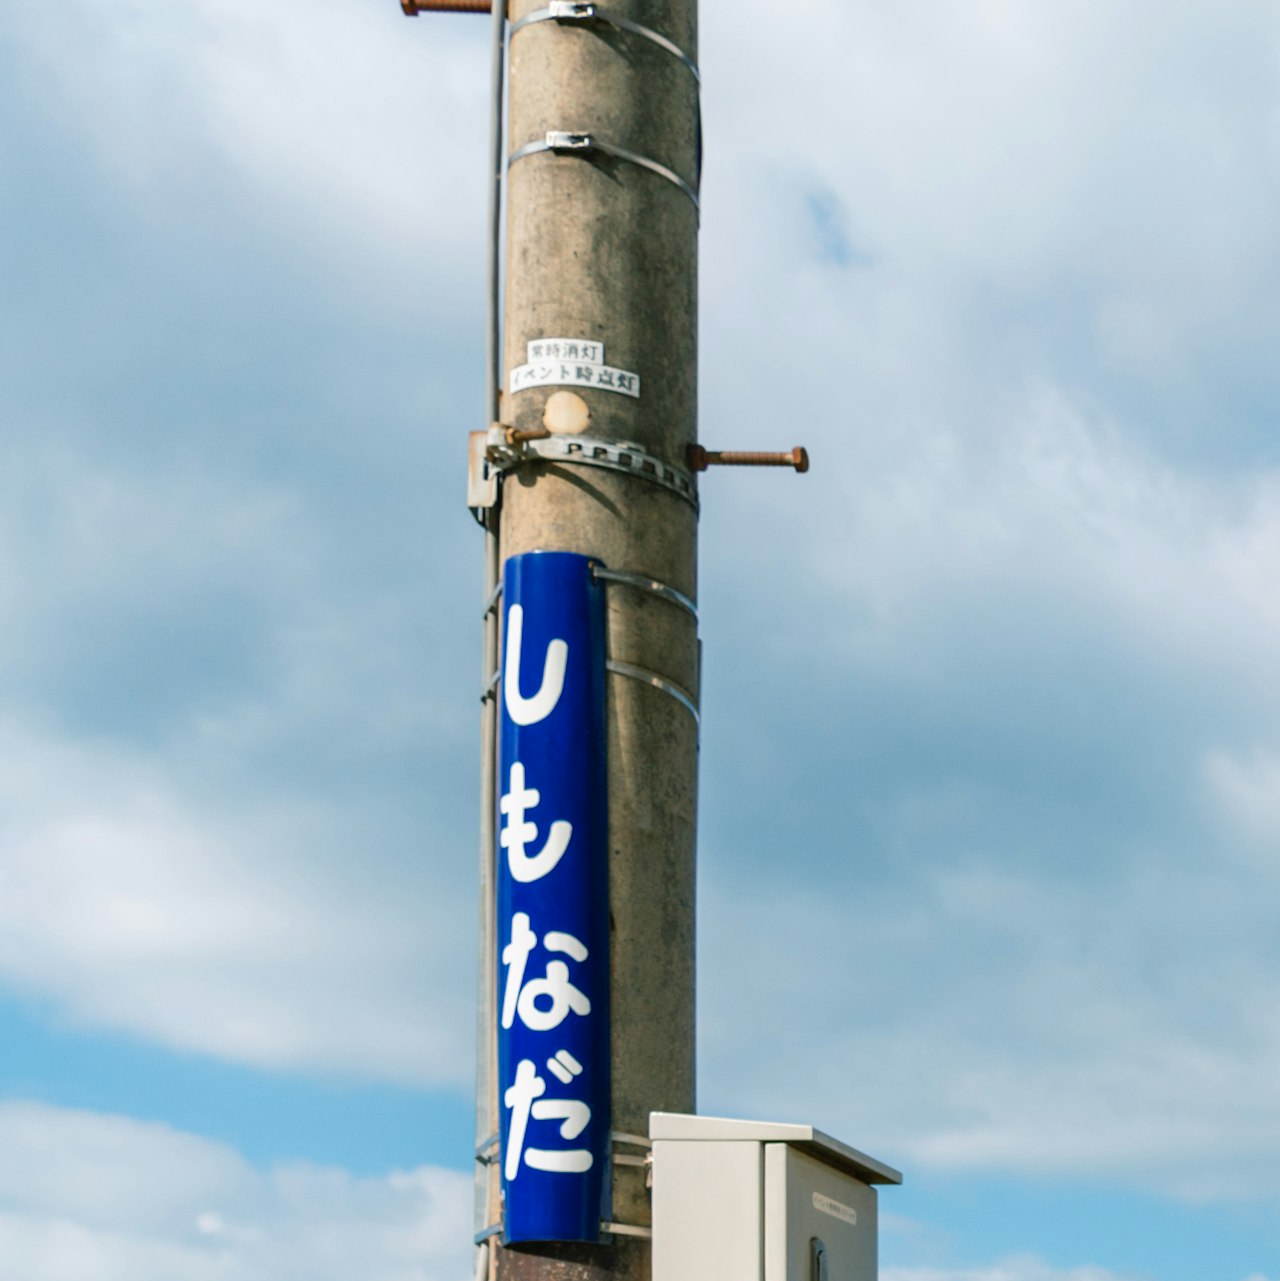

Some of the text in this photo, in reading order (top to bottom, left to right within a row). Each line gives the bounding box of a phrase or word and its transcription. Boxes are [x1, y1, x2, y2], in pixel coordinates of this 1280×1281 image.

[532, 342, 599, 361] 常時消灯
[514, 364, 636, 391] イベント時点灯
[501, 603, 593, 1181] しもなだ
